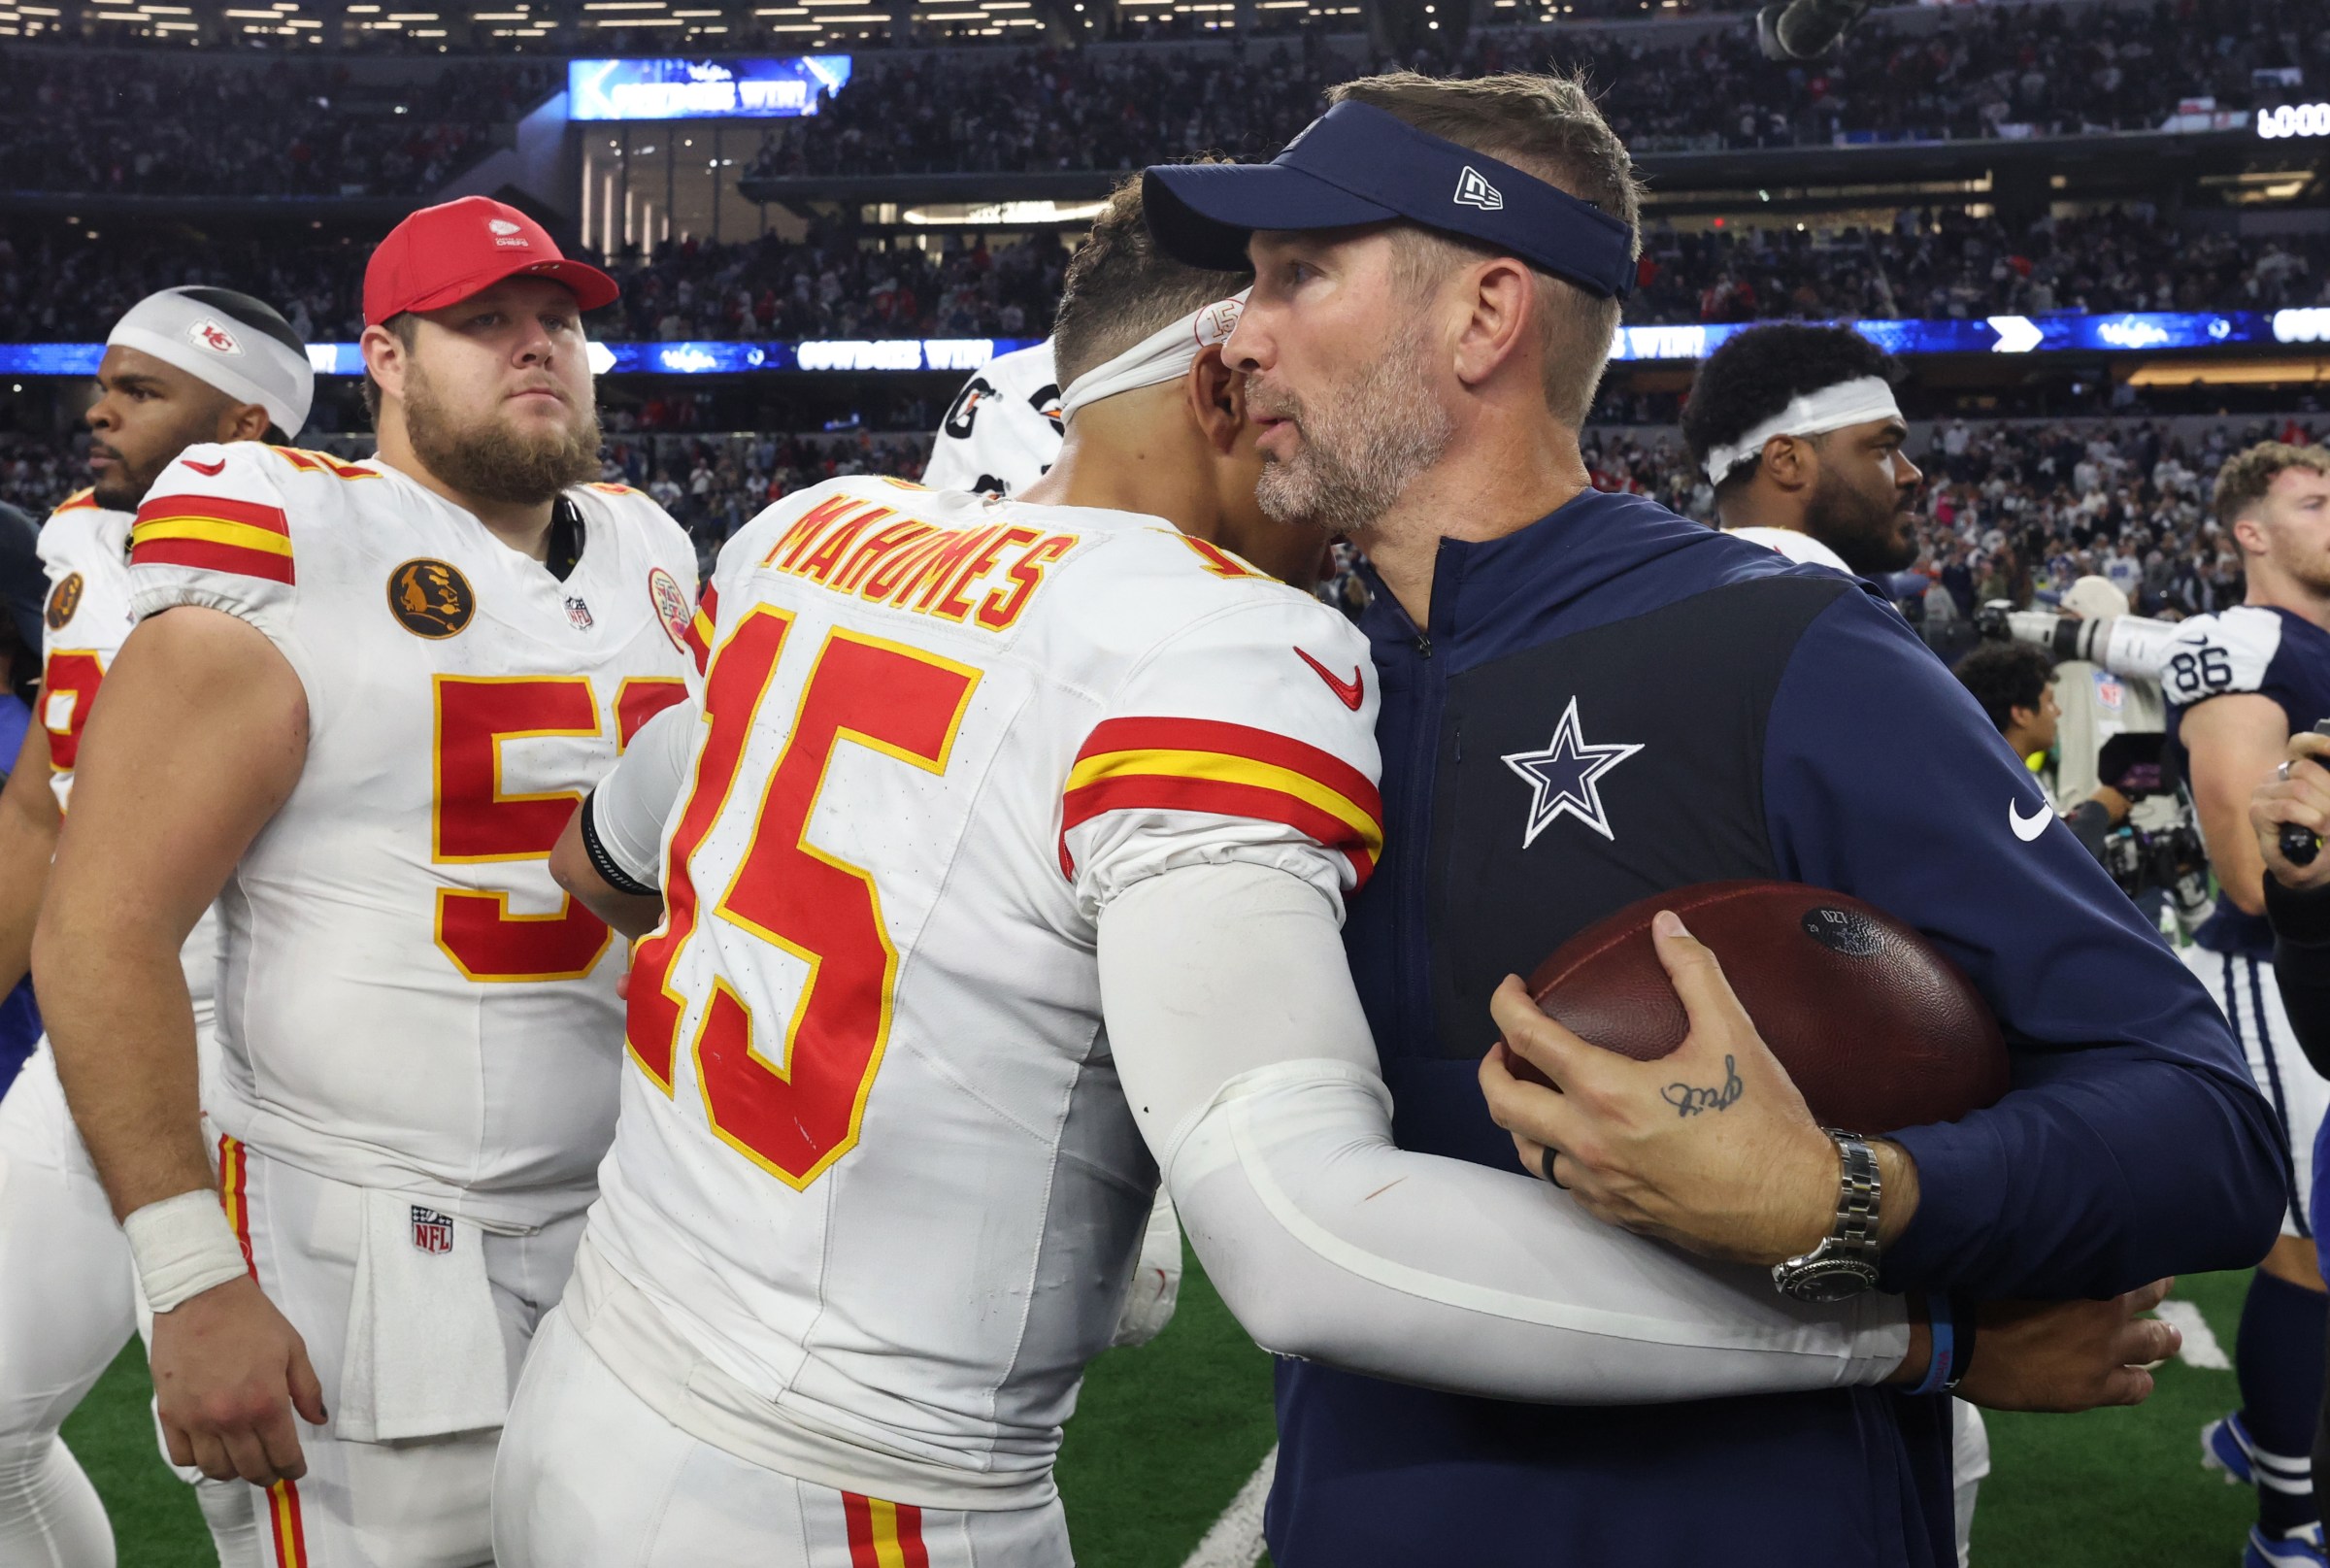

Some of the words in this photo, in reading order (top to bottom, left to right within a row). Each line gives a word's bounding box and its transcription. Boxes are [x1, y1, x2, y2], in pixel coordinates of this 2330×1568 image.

[761, 492, 1080, 633] MAHOMES
[2171, 647, 2232, 692] 86
[624, 601, 984, 1192] 15
[1660, 1054, 1744, 1118] grit
[415, 1223, 449, 1253] NFL
